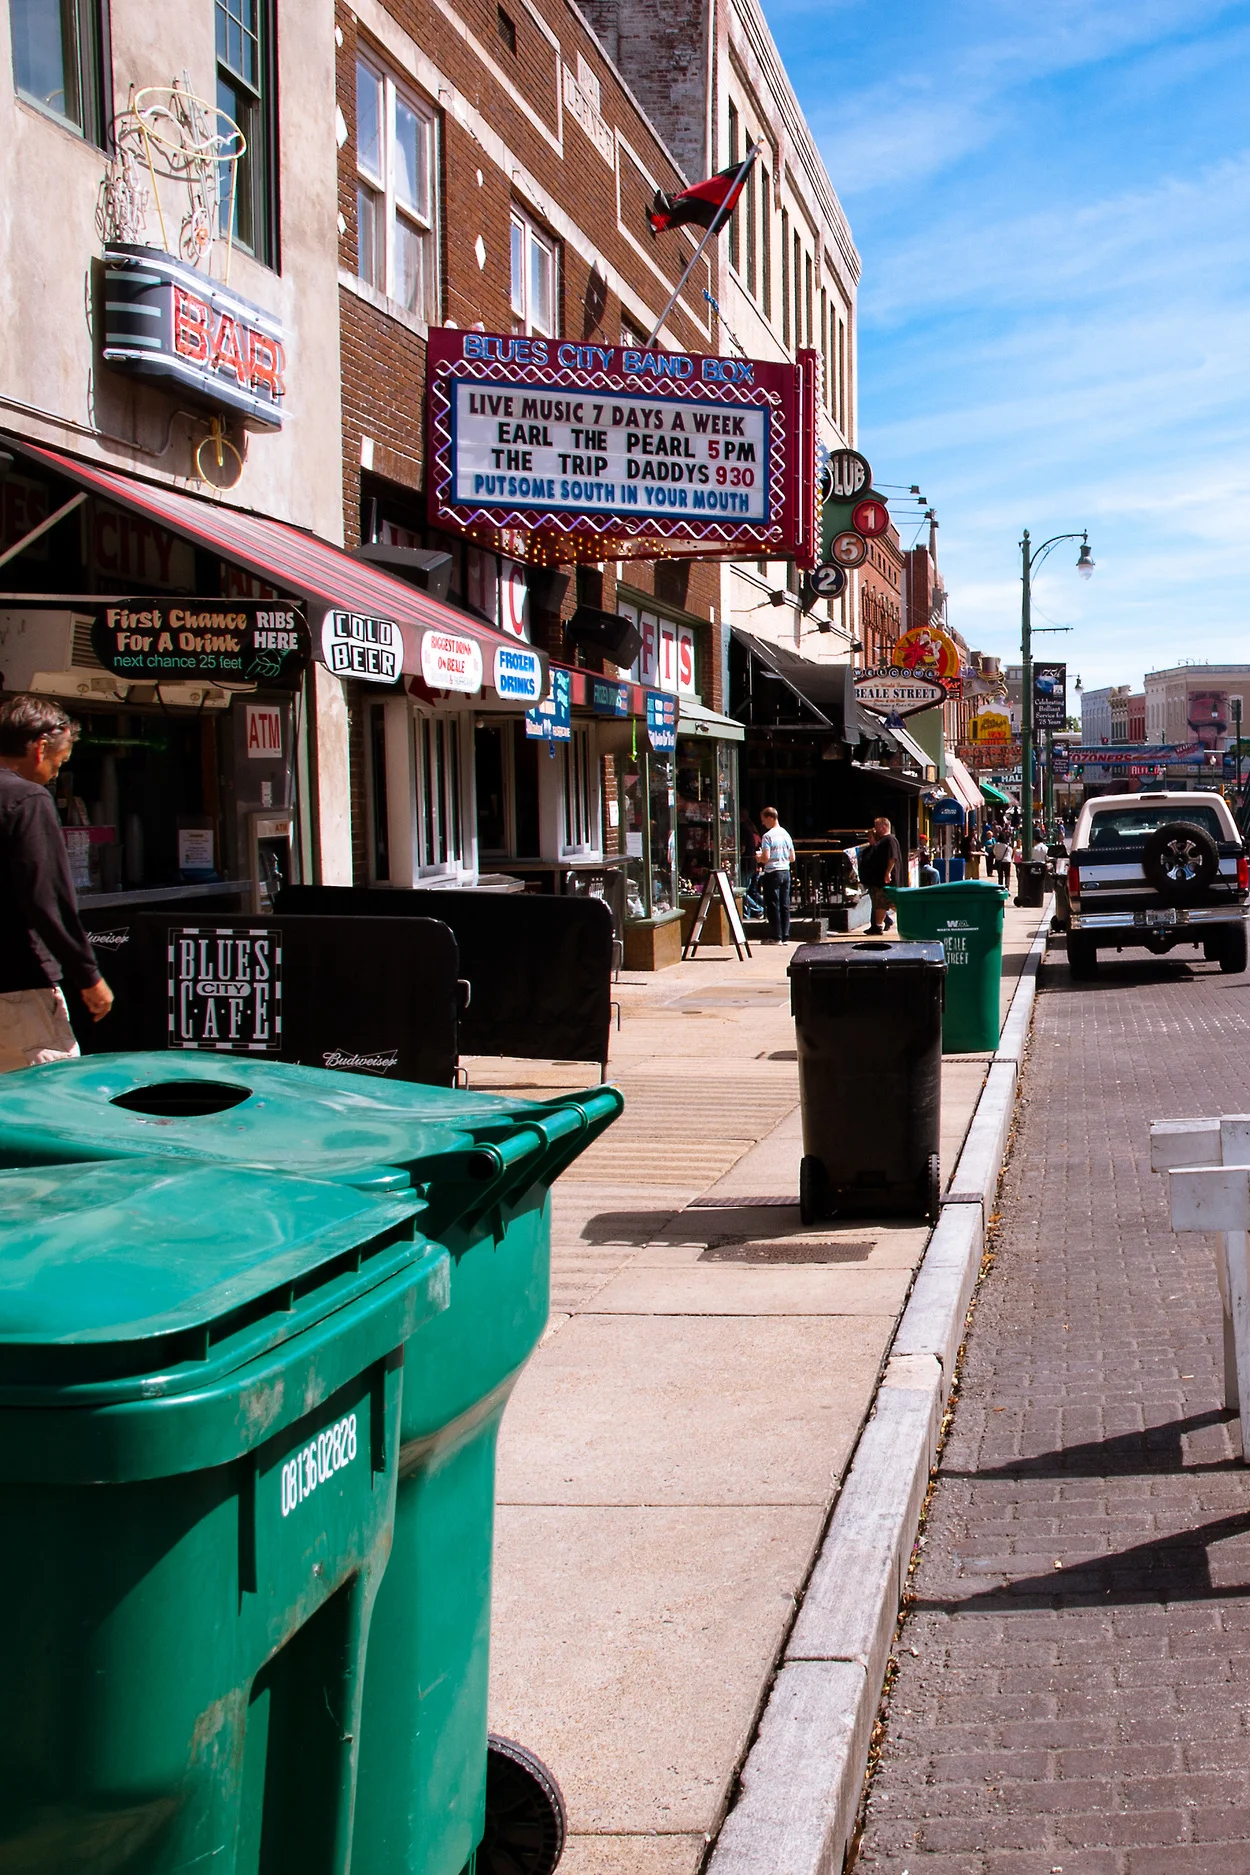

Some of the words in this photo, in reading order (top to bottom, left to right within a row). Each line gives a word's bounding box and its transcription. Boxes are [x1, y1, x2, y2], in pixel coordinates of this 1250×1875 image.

[172, 283, 286, 403] BAR
[463, 334, 548, 366] BLUES
[558, 343, 614, 371] CITY
[623, 350, 694, 380] BAND
[702, 359, 755, 384] BOX
[469, 393, 513, 417] LIVE
[521, 397, 583, 423] MUSIC
[593, 404, 602, 424] 7
[612, 406, 664, 431] DAYS
[671, 411, 686, 431] A
[693, 413, 745, 437] WEEK
[498, 423, 553, 447] EARL
[571, 428, 608, 451] THE
[626, 432, 696, 458] PEARL
[491, 449, 533, 472] THE
[558, 453, 608, 477] TRIP
[626, 459, 710, 484] DADDYS
[715, 465, 755, 488] 930
[829, 455, 866, 496] LUB
[560, 481, 615, 504] SOUTH
[620, 487, 637, 504] IN
[644, 488, 687, 510] YOUR
[692, 492, 749, 513] MOUTH
[863, 507, 877, 530] 1
[95, 511, 176, 583] CITY
[840, 538, 859, 561] 5
[818, 567, 837, 591] 2
[106, 609, 162, 629] First
[169, 609, 247, 630] Chance
[255, 611, 295, 630] RIBS
[334, 611, 393, 646] COLD
[116, 632, 153, 652] For
[157, 632, 174, 653] A
[178, 632, 242, 653] Drink
[253, 631, 299, 650] HERE
[430, 635, 455, 654] BIGGEST
[113, 654, 144, 668] next
[146, 654, 197, 669] chance
[199, 655, 217, 669] 25
[219, 655, 243, 670] feet
[333, 642, 395, 676] BEER
[447, 656, 465, 674] BEALE
[499, 651, 535, 673] FROZEN
[500, 675, 535, 696] DRINKS
[854, 688, 890, 699] BEALE
[893, 688, 937, 699] STREET
[1034, 698, 1065, 706] Celebrating
[250, 713, 281, 750] ATM
[86, 931, 130, 944] weiser
[943, 937, 967, 951] BEALE
[179, 939, 270, 980] BLUES
[946, 952, 970, 965] TREET
[201, 983, 248, 996] CITY
[322, 1049, 398, 1070] Budweiser
[281, 1412, 359, 1519] 0813602828
